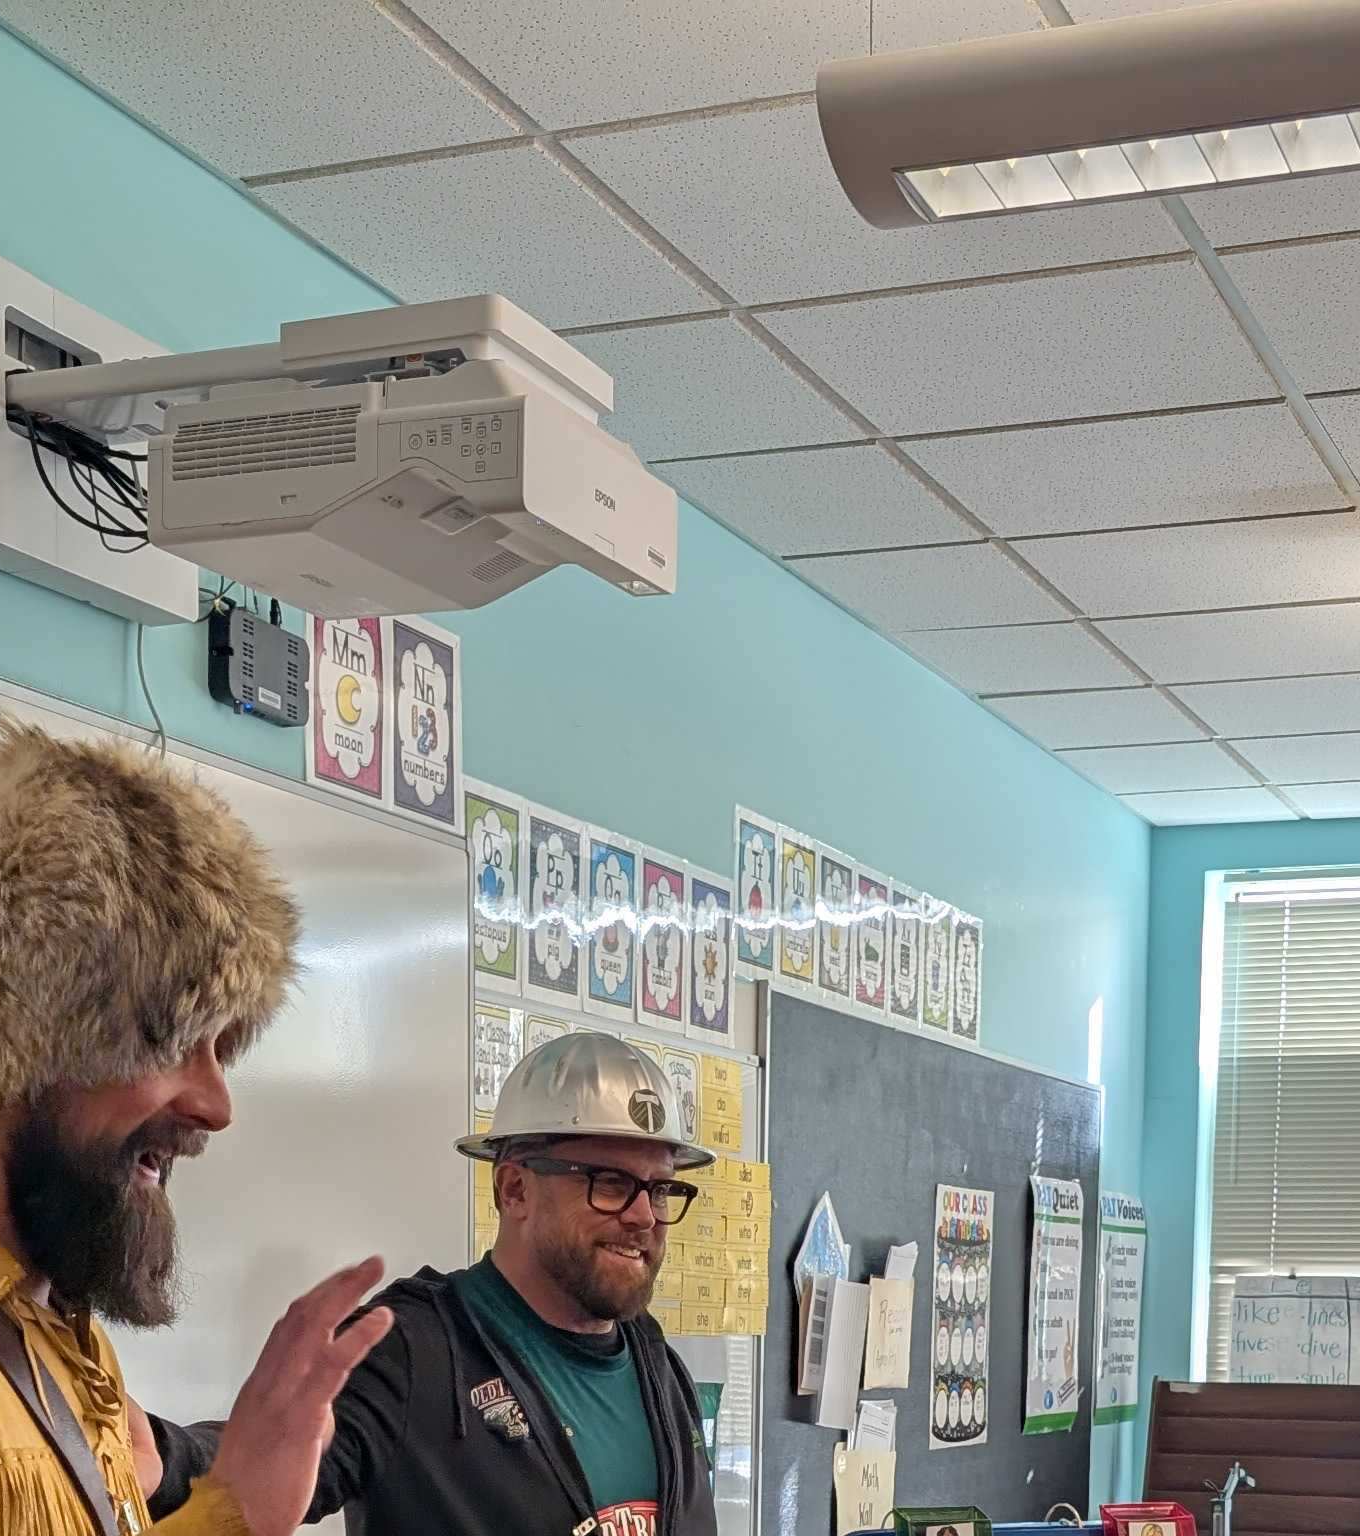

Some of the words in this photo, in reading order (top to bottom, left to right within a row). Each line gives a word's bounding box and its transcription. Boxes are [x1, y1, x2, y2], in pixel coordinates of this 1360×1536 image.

[594, 488, 616, 512] EPSON
[331, 626, 368, 676] Mm
[413, 663, 436, 706] Nn
[333, 730, 365, 755] moon
[403, 756, 446, 787] numbers
[943, 1190, 960, 1213] OUR
[1052, 1186, 1079, 1214] Quiet
[1117, 1199, 1144, 1221] Voices
[1236, 1301, 1281, 1326] like
[1306, 1300, 1348, 1327] lines
[1300, 1333, 1342, 1358] dive
